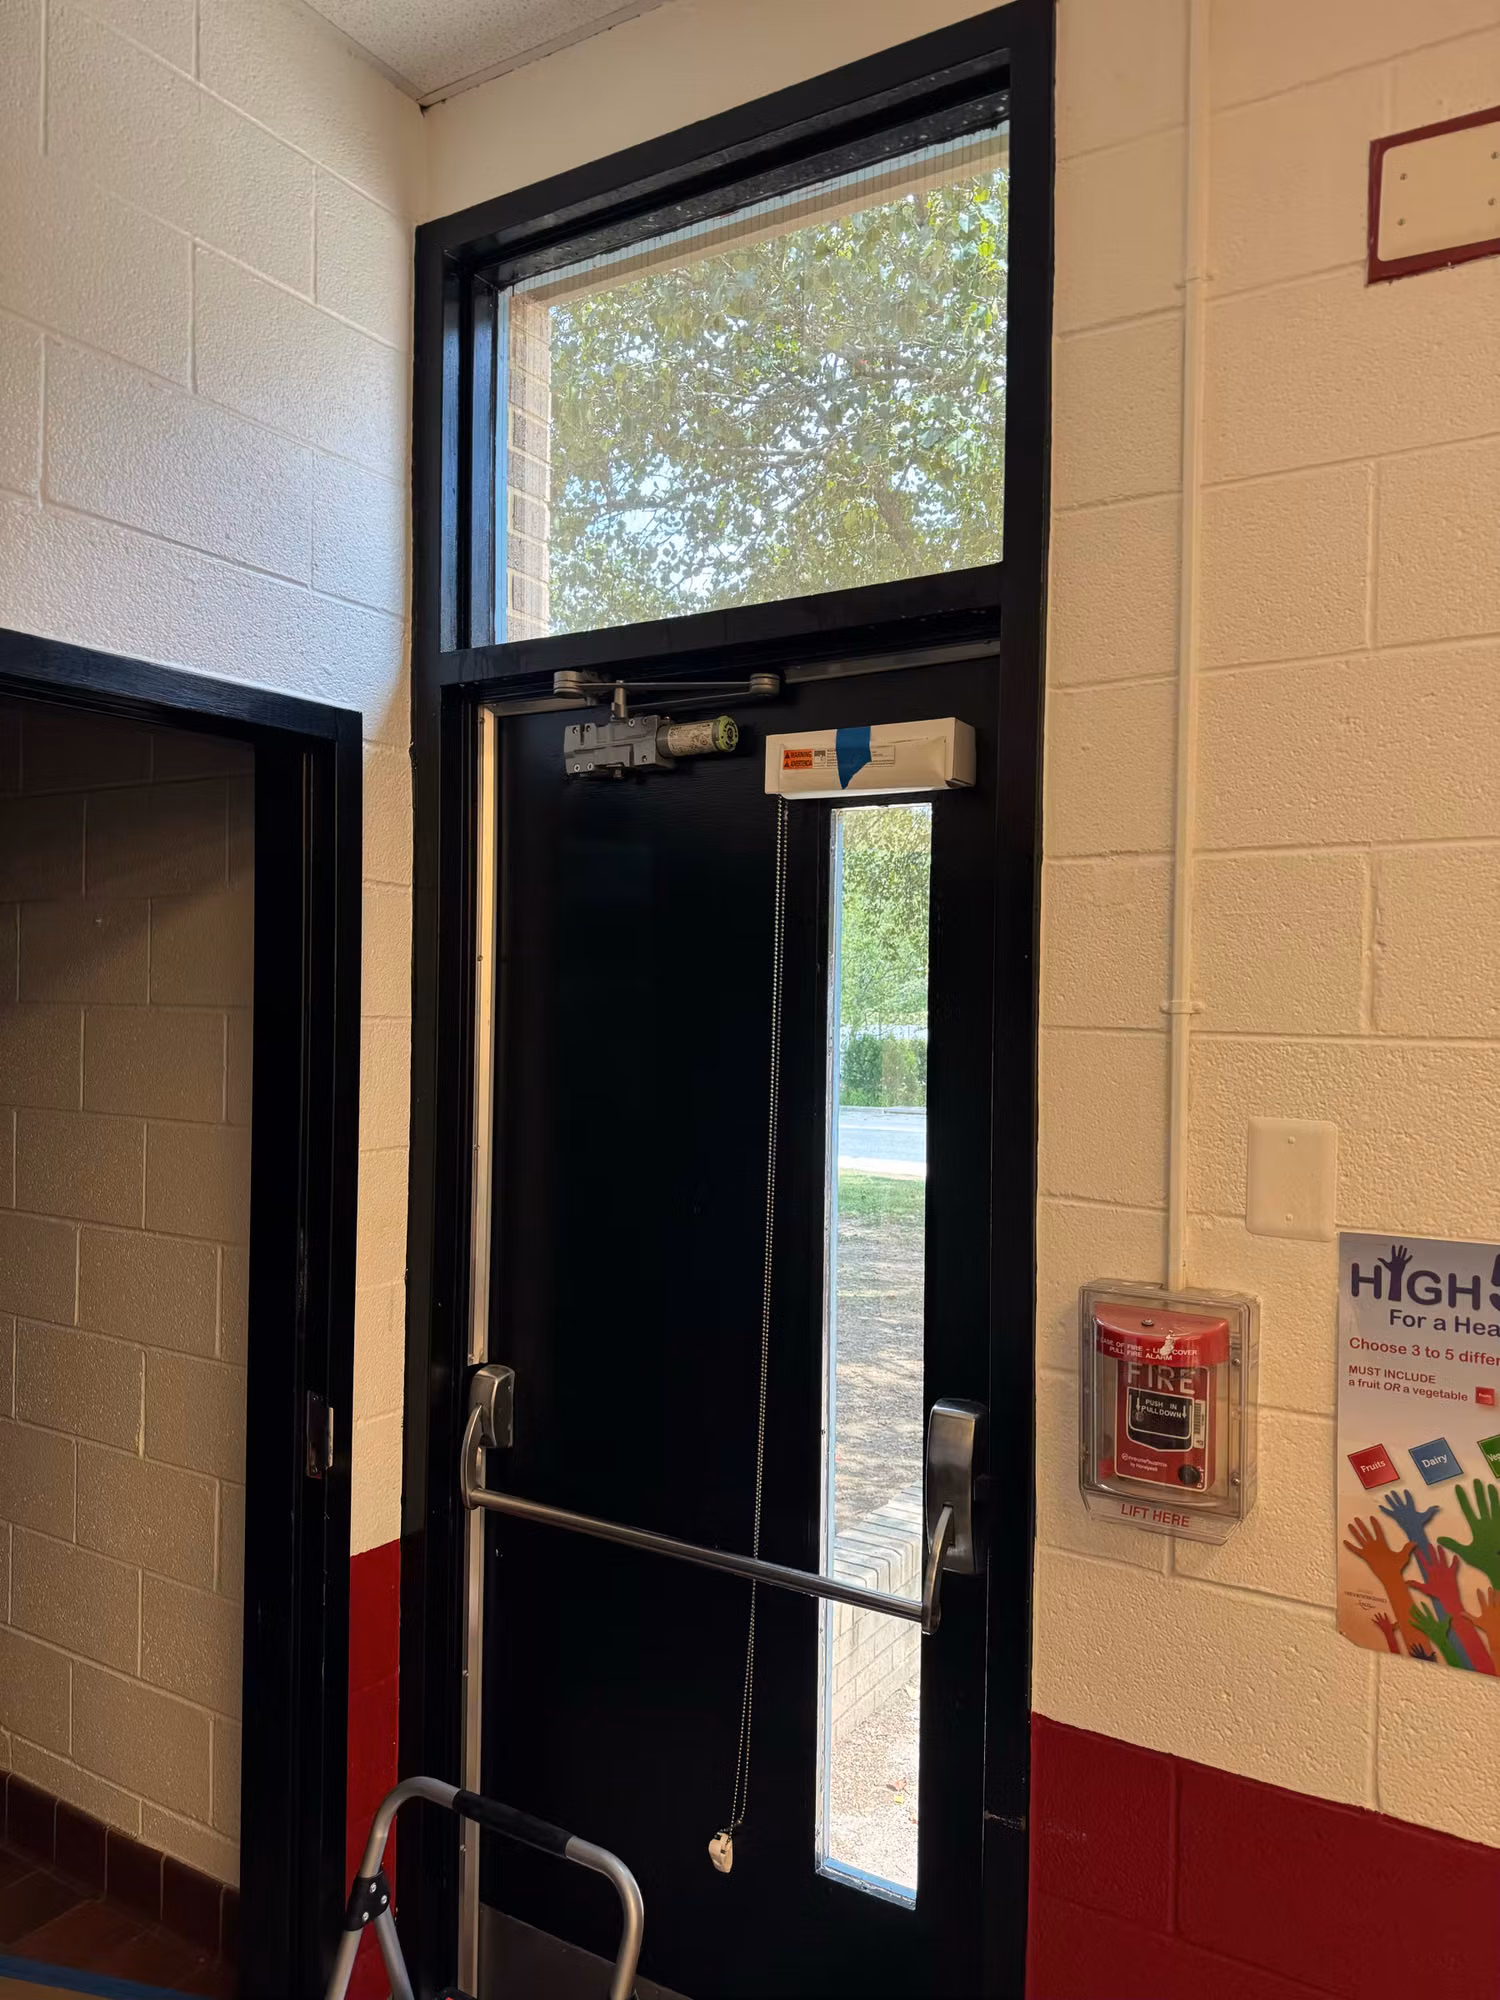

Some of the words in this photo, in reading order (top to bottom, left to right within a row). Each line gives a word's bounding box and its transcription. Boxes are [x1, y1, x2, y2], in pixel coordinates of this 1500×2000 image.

[1351, 1245, 1481, 1311] HIGH
[1389, 1309, 1427, 1329] For
[1433, 1317, 1446, 1331] a
[1109, 1346, 1124, 1355] PULL
[1126, 1350, 1143, 1358] FIRE
[1127, 1344, 1143, 1352] FIRE
[1349, 1337, 1407, 1355] Choose
[1411, 1344, 1421, 1357] 3
[1425, 1346, 1440, 1359] to
[1444, 1348, 1455, 1361] 5
[1128, 1361, 1195, 1395] FIRE
[1348, 1365, 1381, 1377] MUST
[1384, 1369, 1437, 1384] INCLUDE
[1357, 1378, 1380, 1390] fruit
[1383, 1382, 1401, 1392] OR
[1402, 1386, 1410, 1394] a
[1412, 1386, 1468, 1402] vegetable
[1141, 1405, 1159, 1415] PULL
[1159, 1408, 1182, 1419] DOWN
[1145, 1399, 1164, 1409] PUSH
[1170, 1401, 1177, 1410] IN
[1360, 1459, 1386, 1473] Fruits
[1421, 1454, 1448, 1468] Dairy
[1121, 1503, 1149, 1519] LIFT
[1152, 1510, 1191, 1528] HERE
